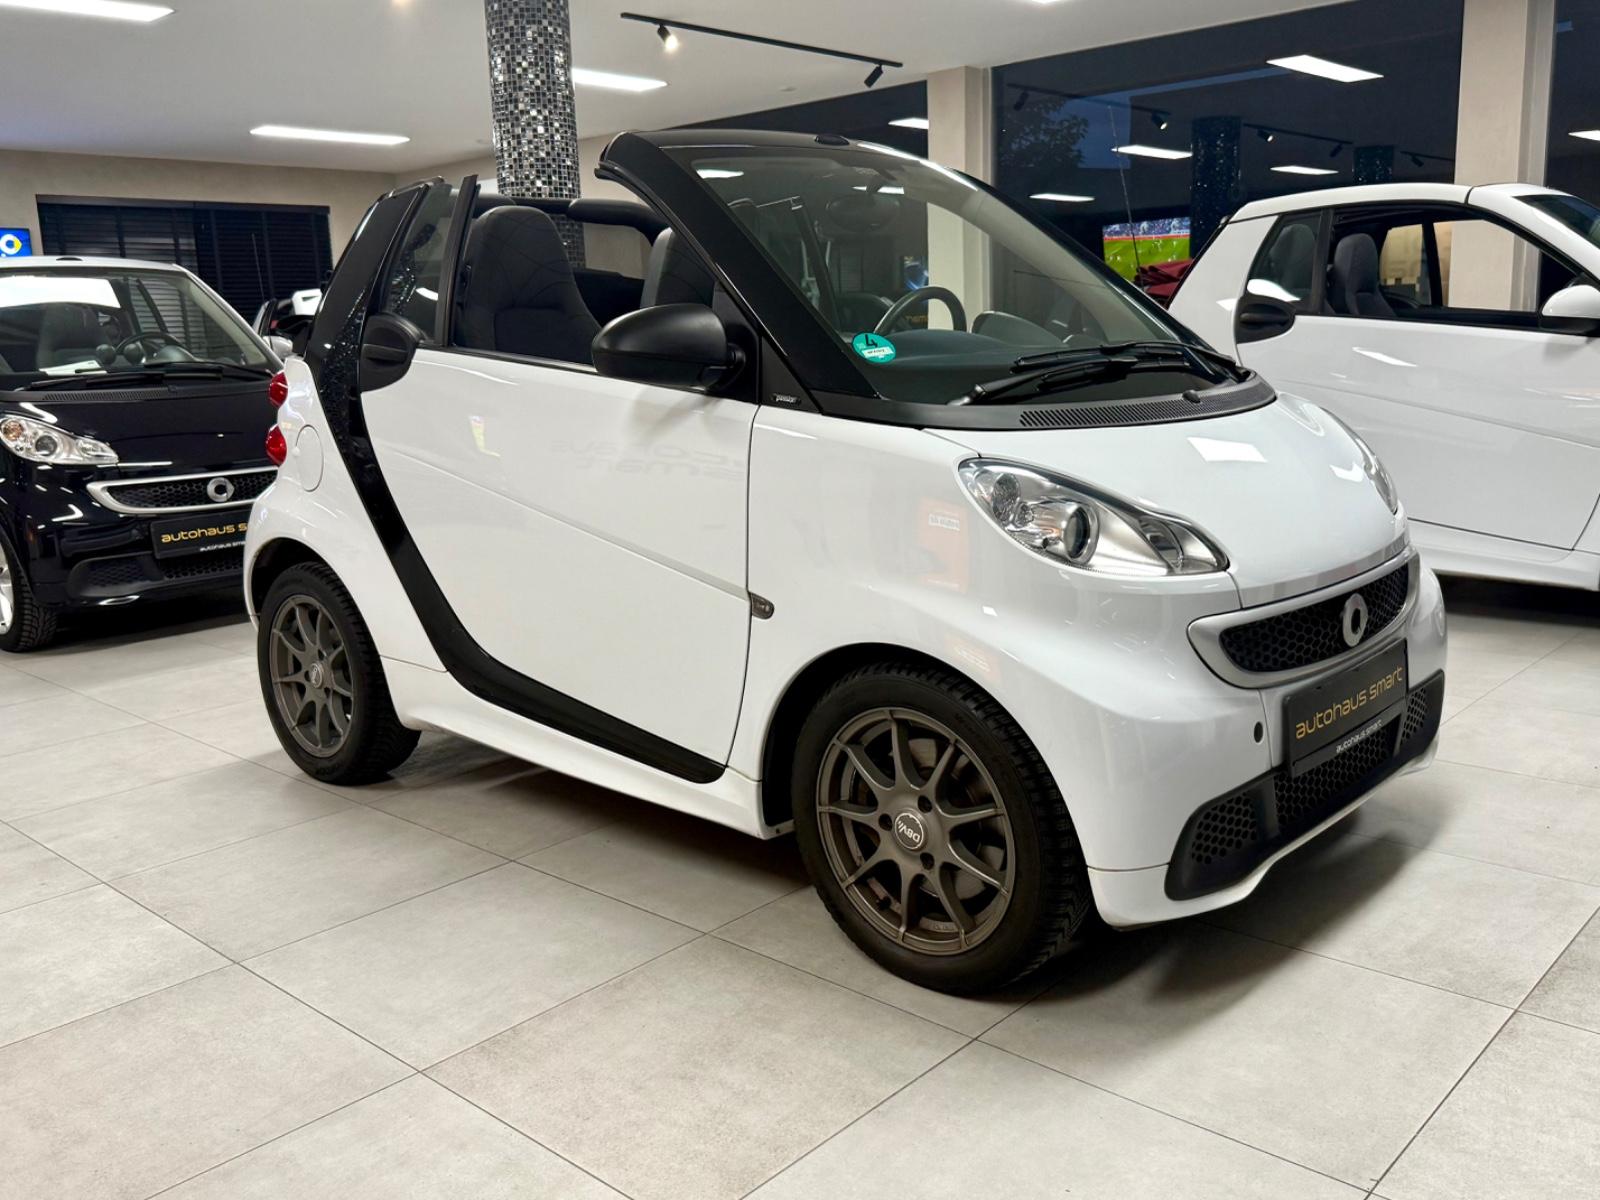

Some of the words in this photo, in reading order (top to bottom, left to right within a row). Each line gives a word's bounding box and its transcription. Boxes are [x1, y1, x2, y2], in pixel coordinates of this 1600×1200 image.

[161, 525, 236, 543] autohaus
[1295, 690, 1368, 740] autohaus
[1369, 666, 1403, 700] smart
[1336, 729, 1366, 754] autohaus
